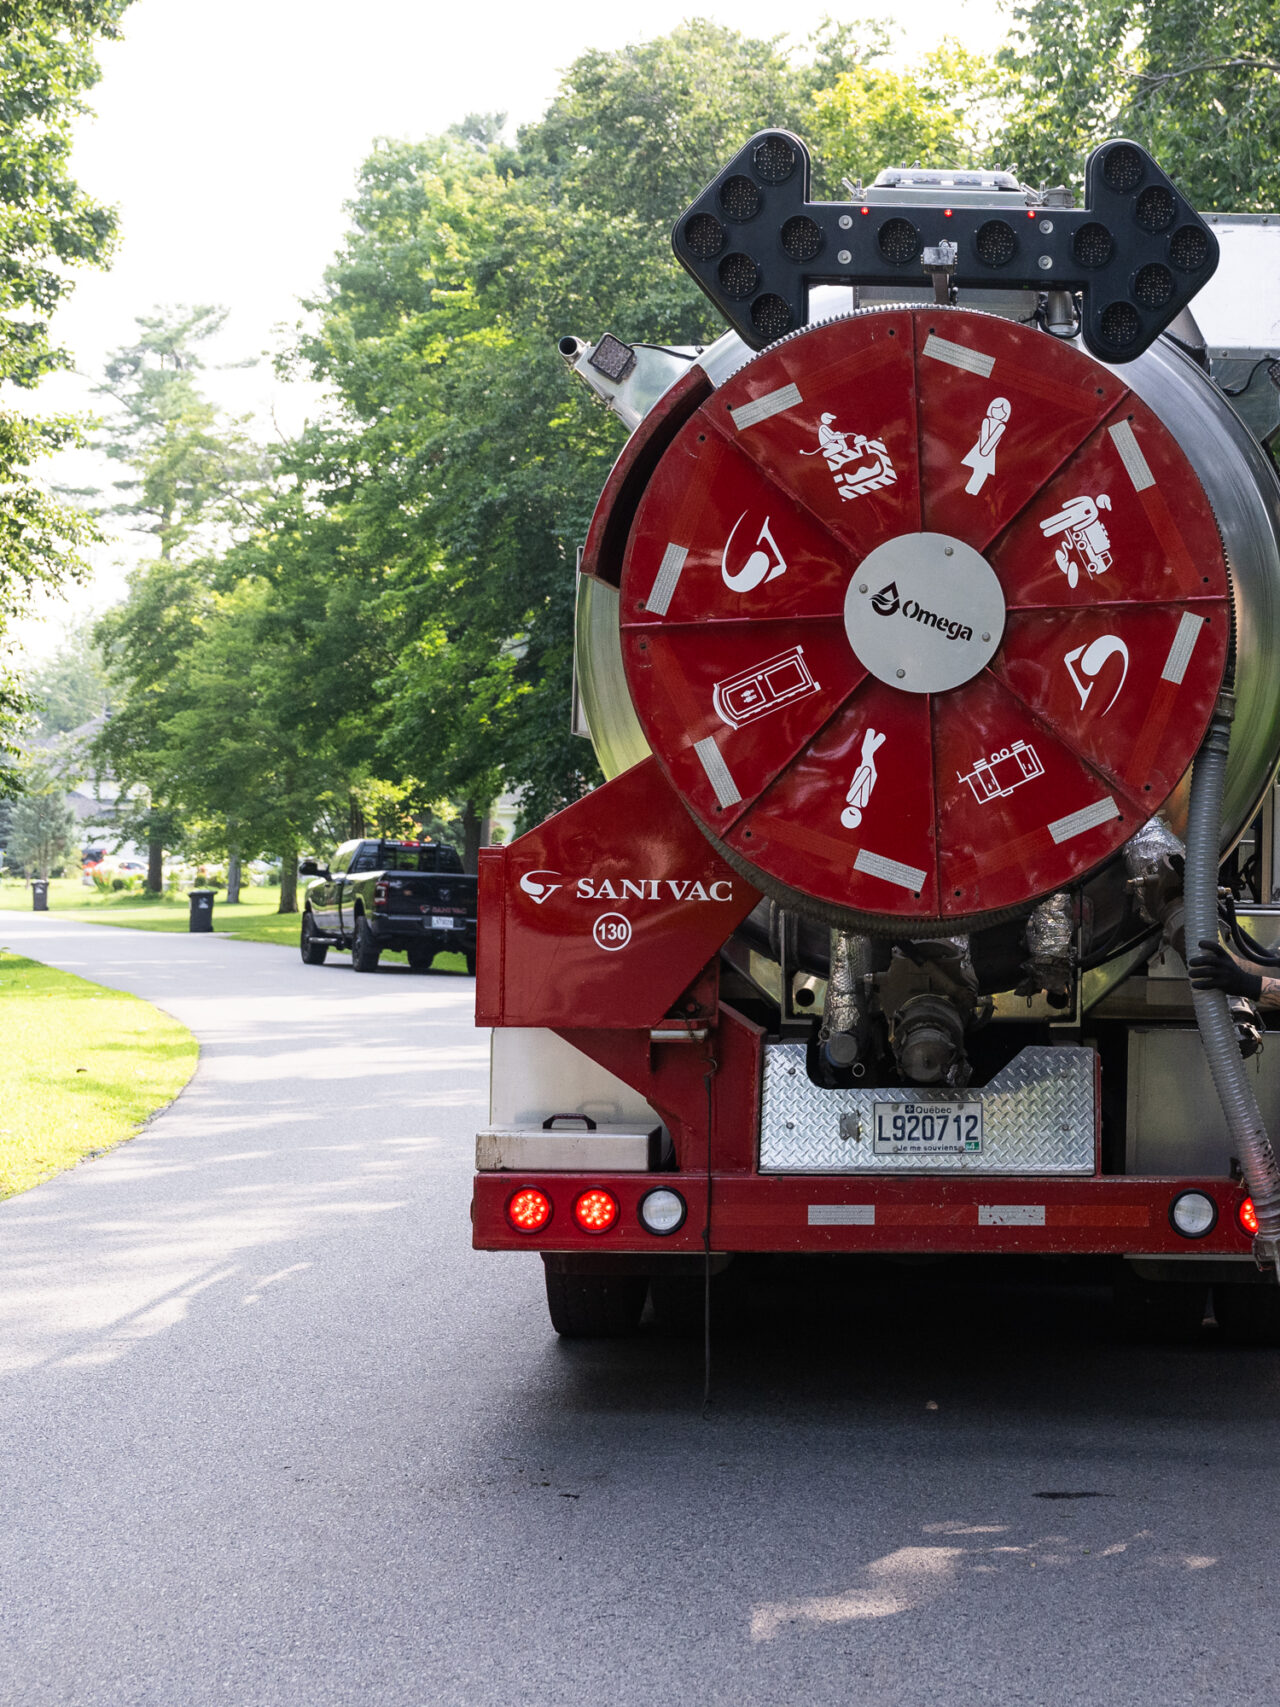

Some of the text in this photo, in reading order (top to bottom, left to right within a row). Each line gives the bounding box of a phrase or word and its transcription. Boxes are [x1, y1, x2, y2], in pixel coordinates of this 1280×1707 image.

[902, 600, 973, 641] Omega
[598, 923, 627, 940] 130
[915, 1105, 952, 1114] Québec
[878, 1115, 979, 1141] L920712
